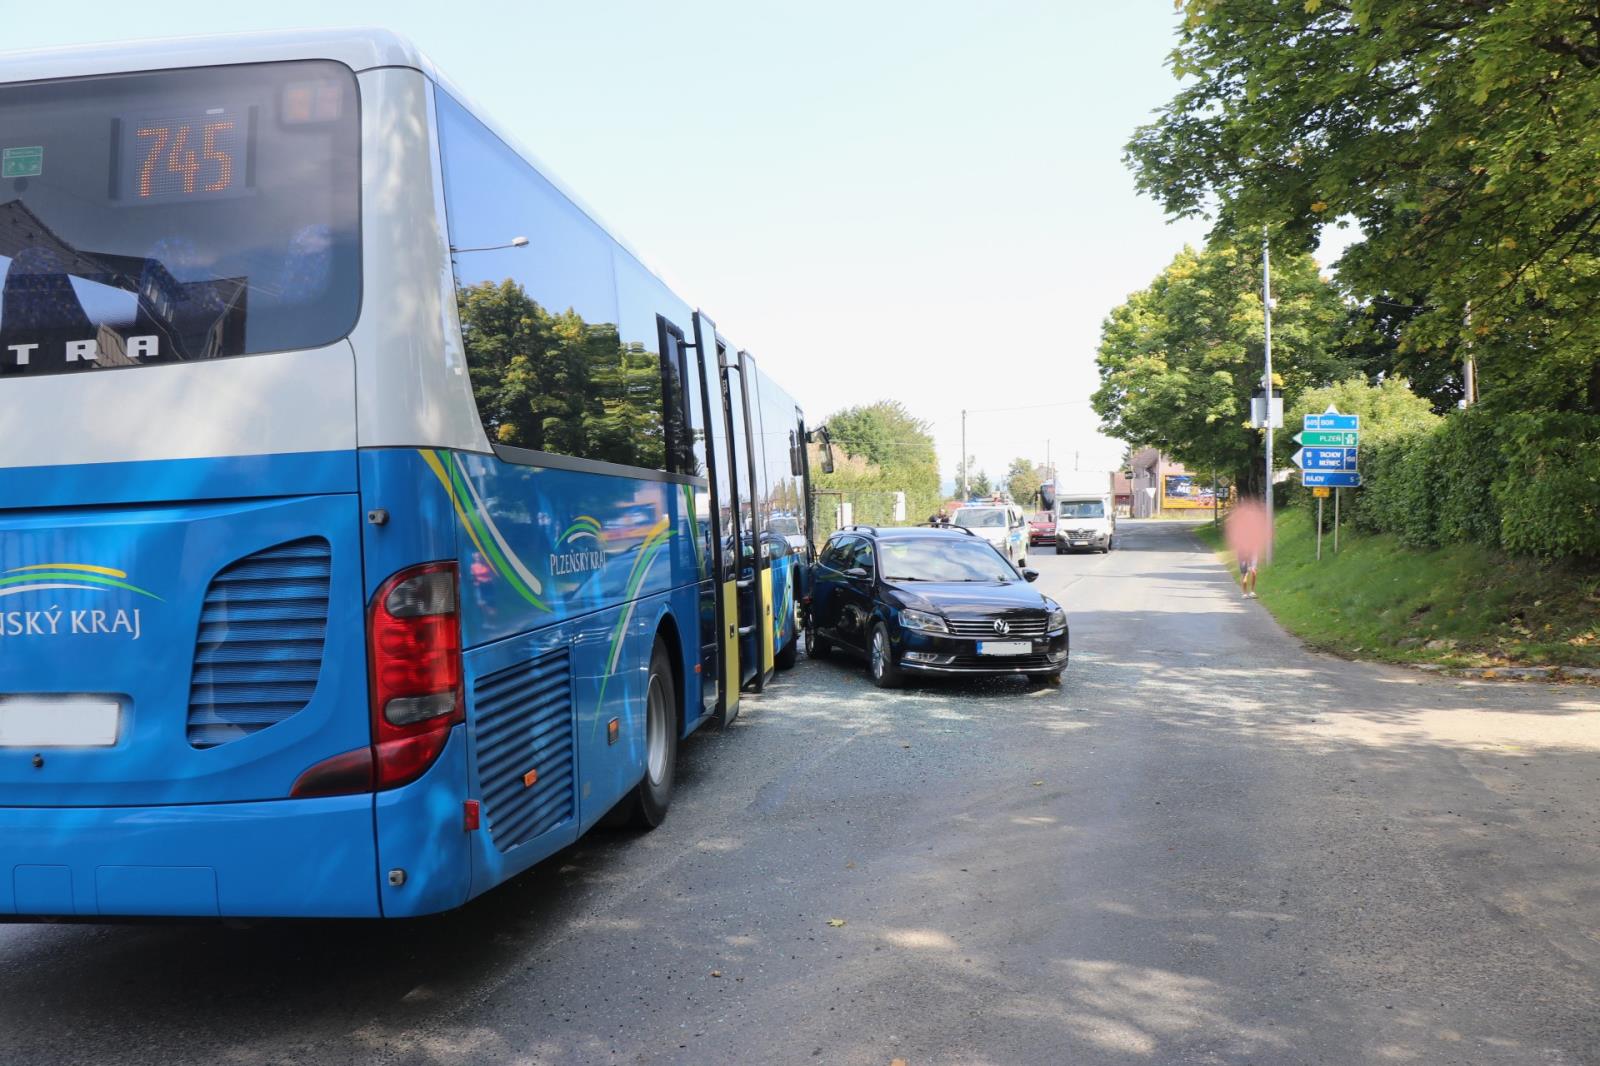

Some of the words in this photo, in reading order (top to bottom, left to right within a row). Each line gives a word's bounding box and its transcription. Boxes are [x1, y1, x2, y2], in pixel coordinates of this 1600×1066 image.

[136, 121, 234, 197] 745
[550, 547, 589, 576] PLZEŇSKÝ
[0, 604, 63, 636] SKÝ
[70, 608, 141, 640] KRAJ
